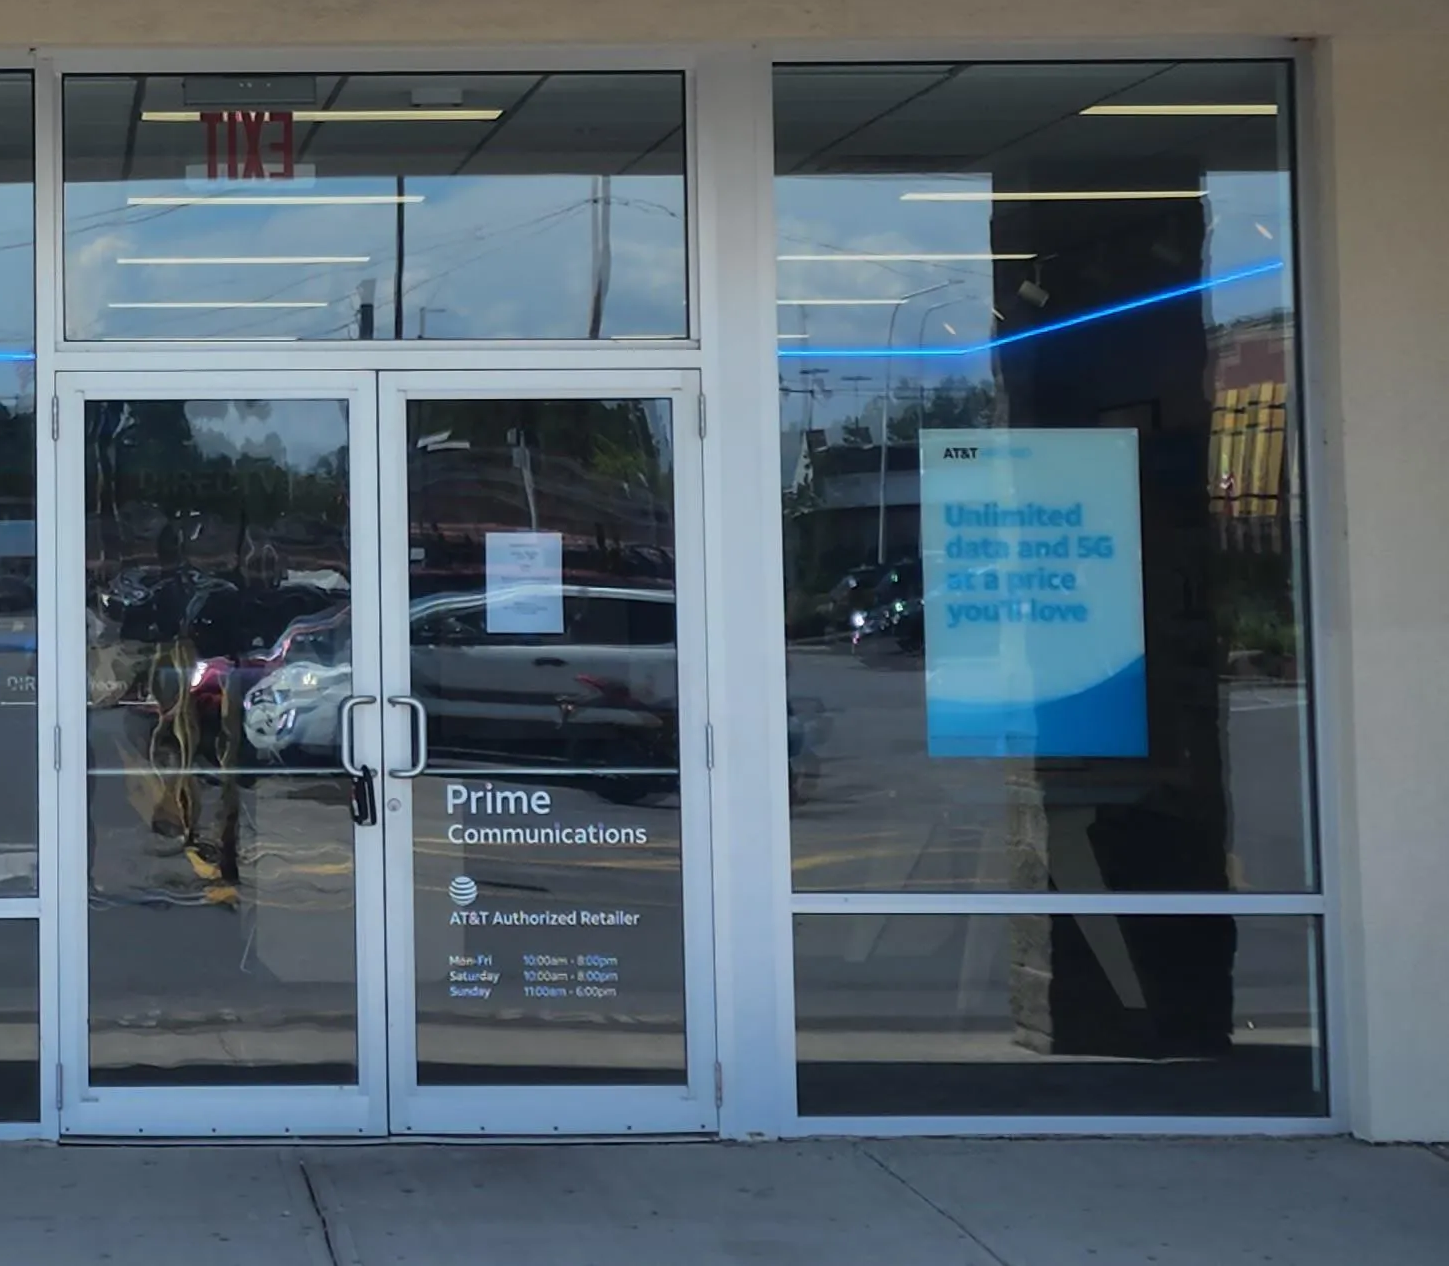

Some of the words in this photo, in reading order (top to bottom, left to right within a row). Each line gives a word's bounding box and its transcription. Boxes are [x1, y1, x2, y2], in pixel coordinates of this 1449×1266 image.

[943, 447, 978, 459] AT&T
[945, 502, 1083, 527] Unlimited
[946, 535, 1009, 559] data
[1018, 535, 1070, 559] and
[1077, 536, 1114, 559] 5G
[947, 570, 975, 591] at
[984, 572, 999, 591] a
[1007, 567, 1076, 595] price
[947, 599, 1023, 628] you'll
[1031, 598, 1088, 622] love
[446, 782, 551, 815] Prime
[448, 822, 647, 844] Communications
[450, 911, 489, 925] AT&T
[492, 910, 577, 926] Authorized
[580, 910, 640, 925] Retailer
[449, 955, 492, 967] Mon-Fri
[523, 955, 568, 967] 10:00am
[577, 955, 618, 968] 8:00pm
[449, 970, 500, 983] Saturday
[523, 970, 568, 982] 10:00am
[577, 970, 618, 983] 8:00pm
[450, 986, 492, 999] Sunday
[524, 986, 567, 997] 11:00am
[576, 986, 617, 998] 6:00pm
